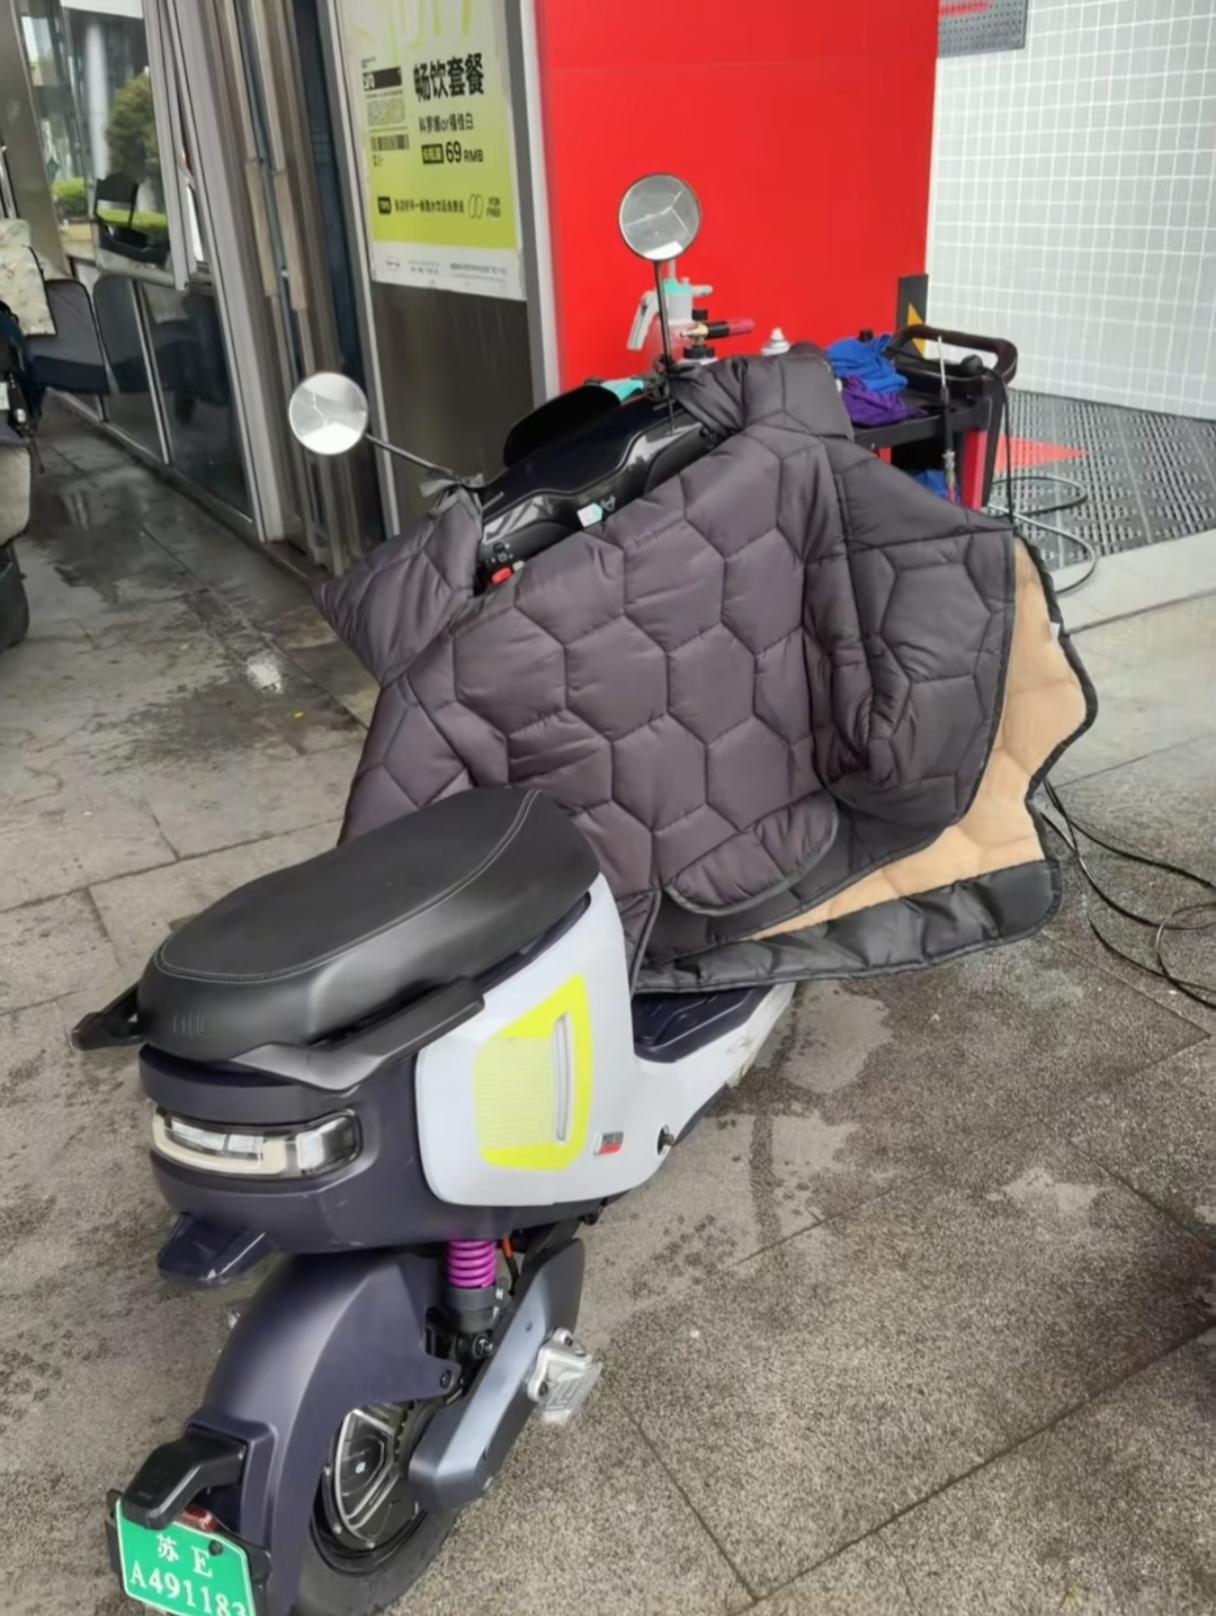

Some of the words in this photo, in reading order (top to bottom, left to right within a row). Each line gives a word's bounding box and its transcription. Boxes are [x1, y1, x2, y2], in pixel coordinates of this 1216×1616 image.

[414, 53, 484, 101] 畅饮套餐
[445, 142, 462, 163] 69
[464, 149, 484, 163] RMB
[157, 1535, 179, 1561] 苏
[191, 1547, 213, 1579] E
